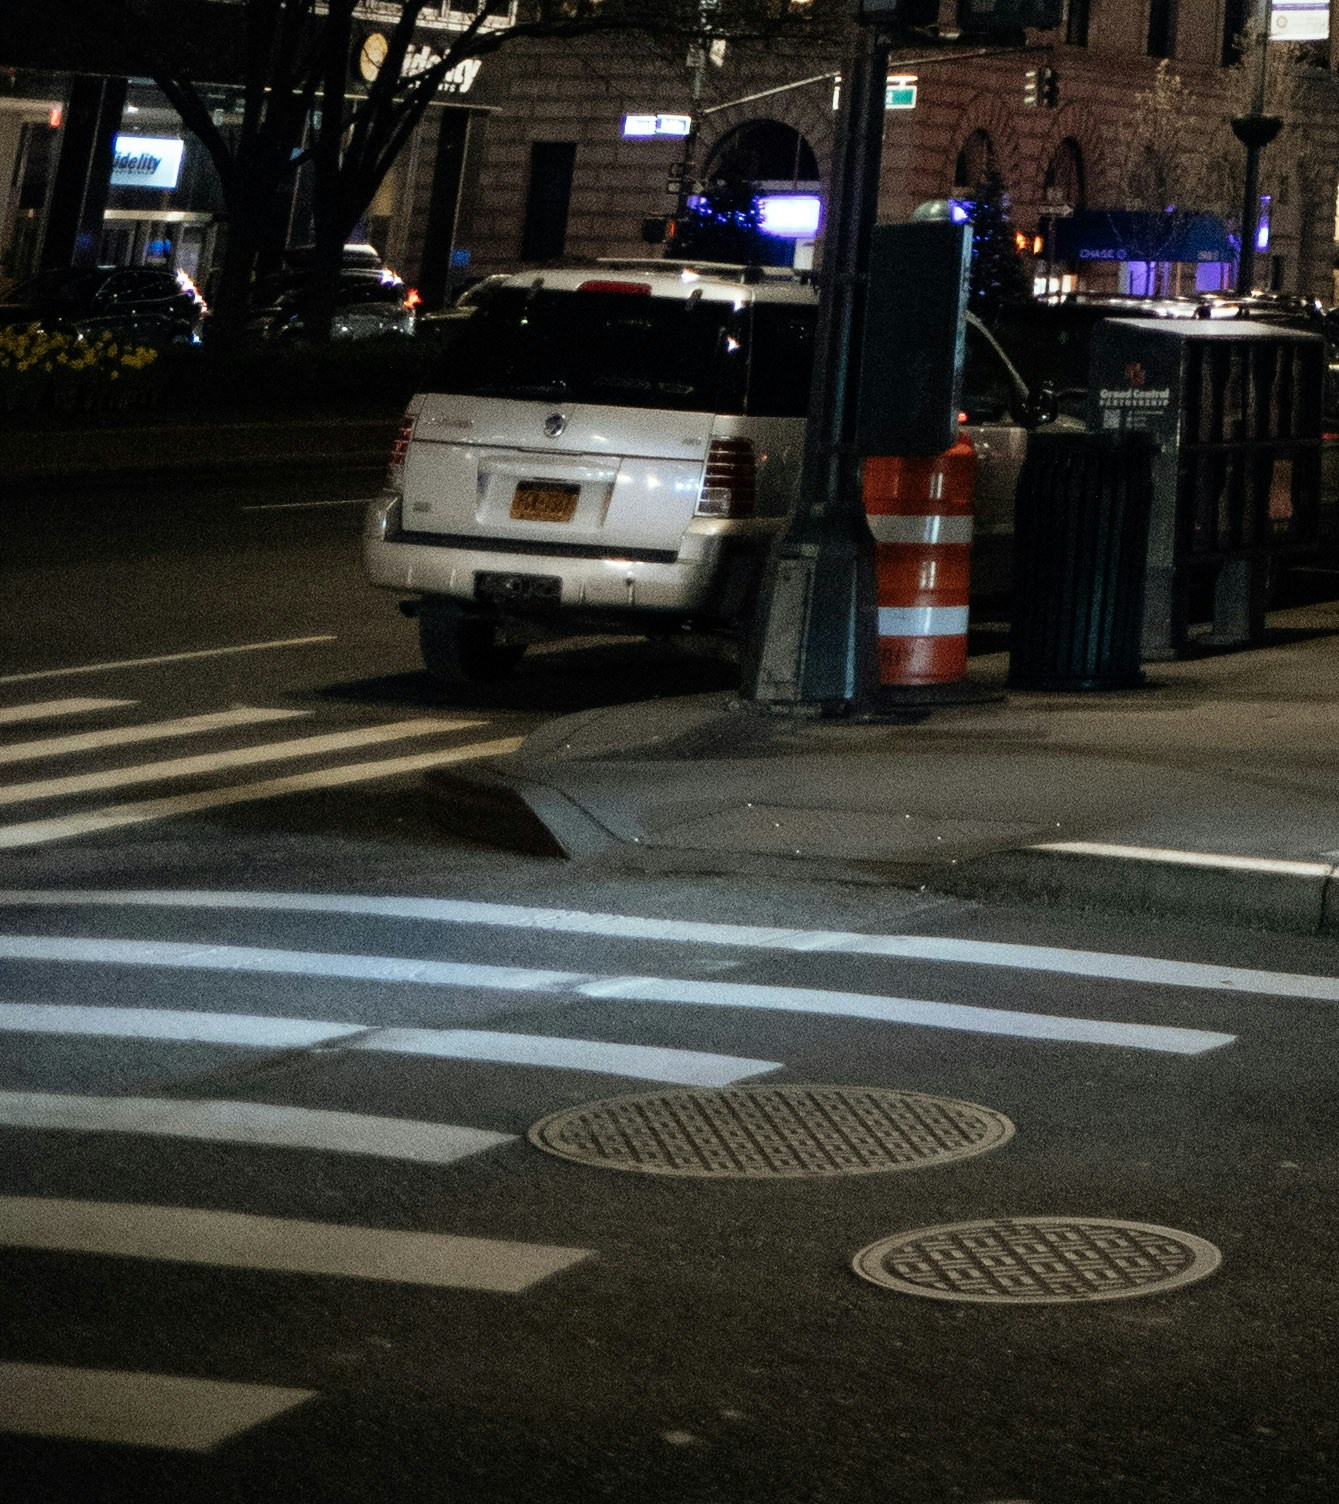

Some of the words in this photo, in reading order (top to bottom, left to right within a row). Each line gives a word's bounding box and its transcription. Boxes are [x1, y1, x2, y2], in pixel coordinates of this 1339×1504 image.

[1079, 248, 1115, 259] CHASE
[1100, 388, 1132, 399] Grand
[1133, 388, 1170, 399] Central
